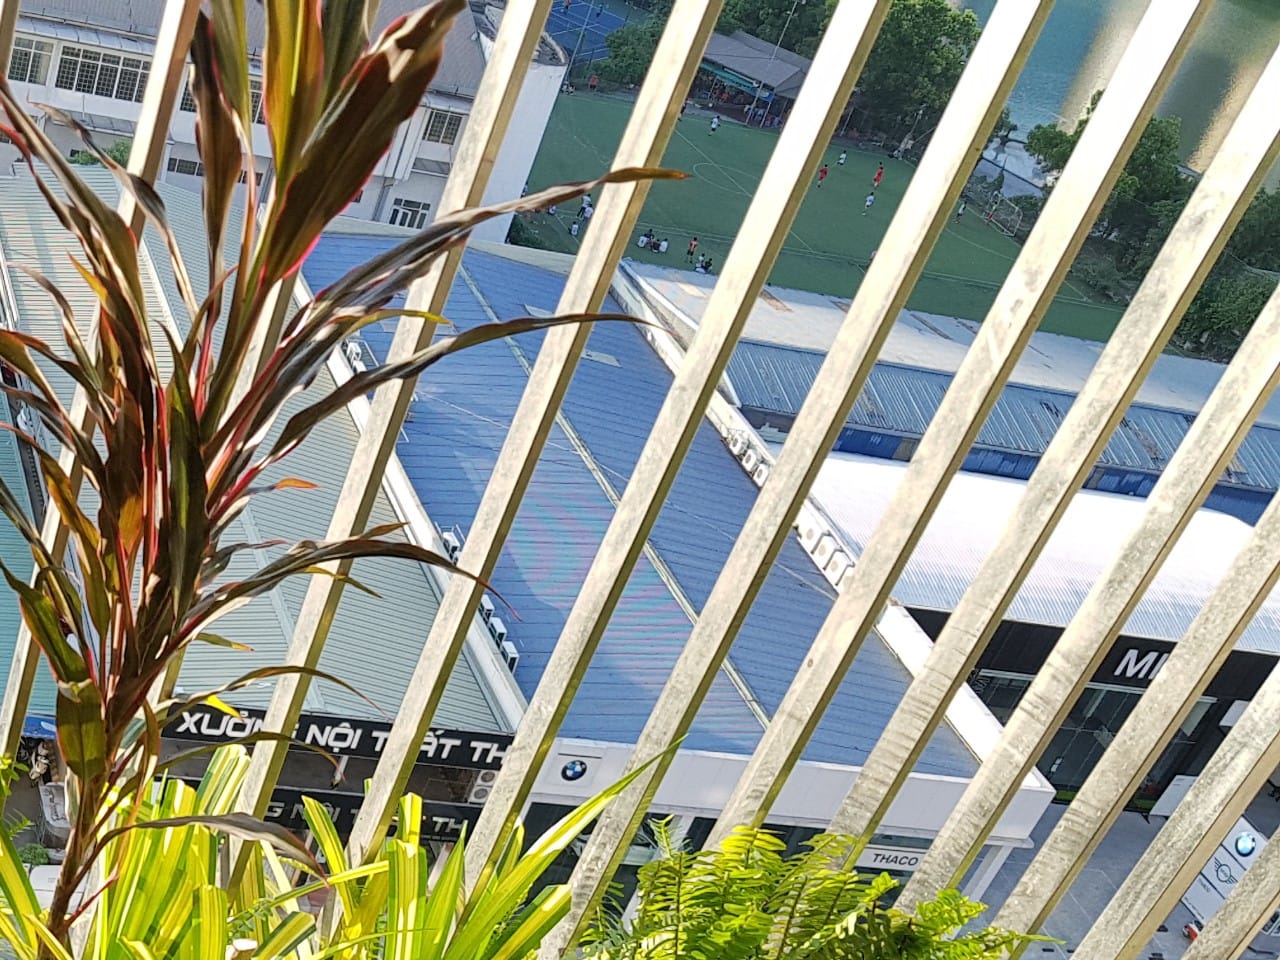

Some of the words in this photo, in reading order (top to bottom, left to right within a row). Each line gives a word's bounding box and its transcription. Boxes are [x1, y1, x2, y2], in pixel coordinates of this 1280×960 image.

[1114, 649, 1170, 679] MI
[306, 723, 361, 752] NỘI
[371, 730, 463, 759] TẤT
[873, 853, 919, 866] THACO
